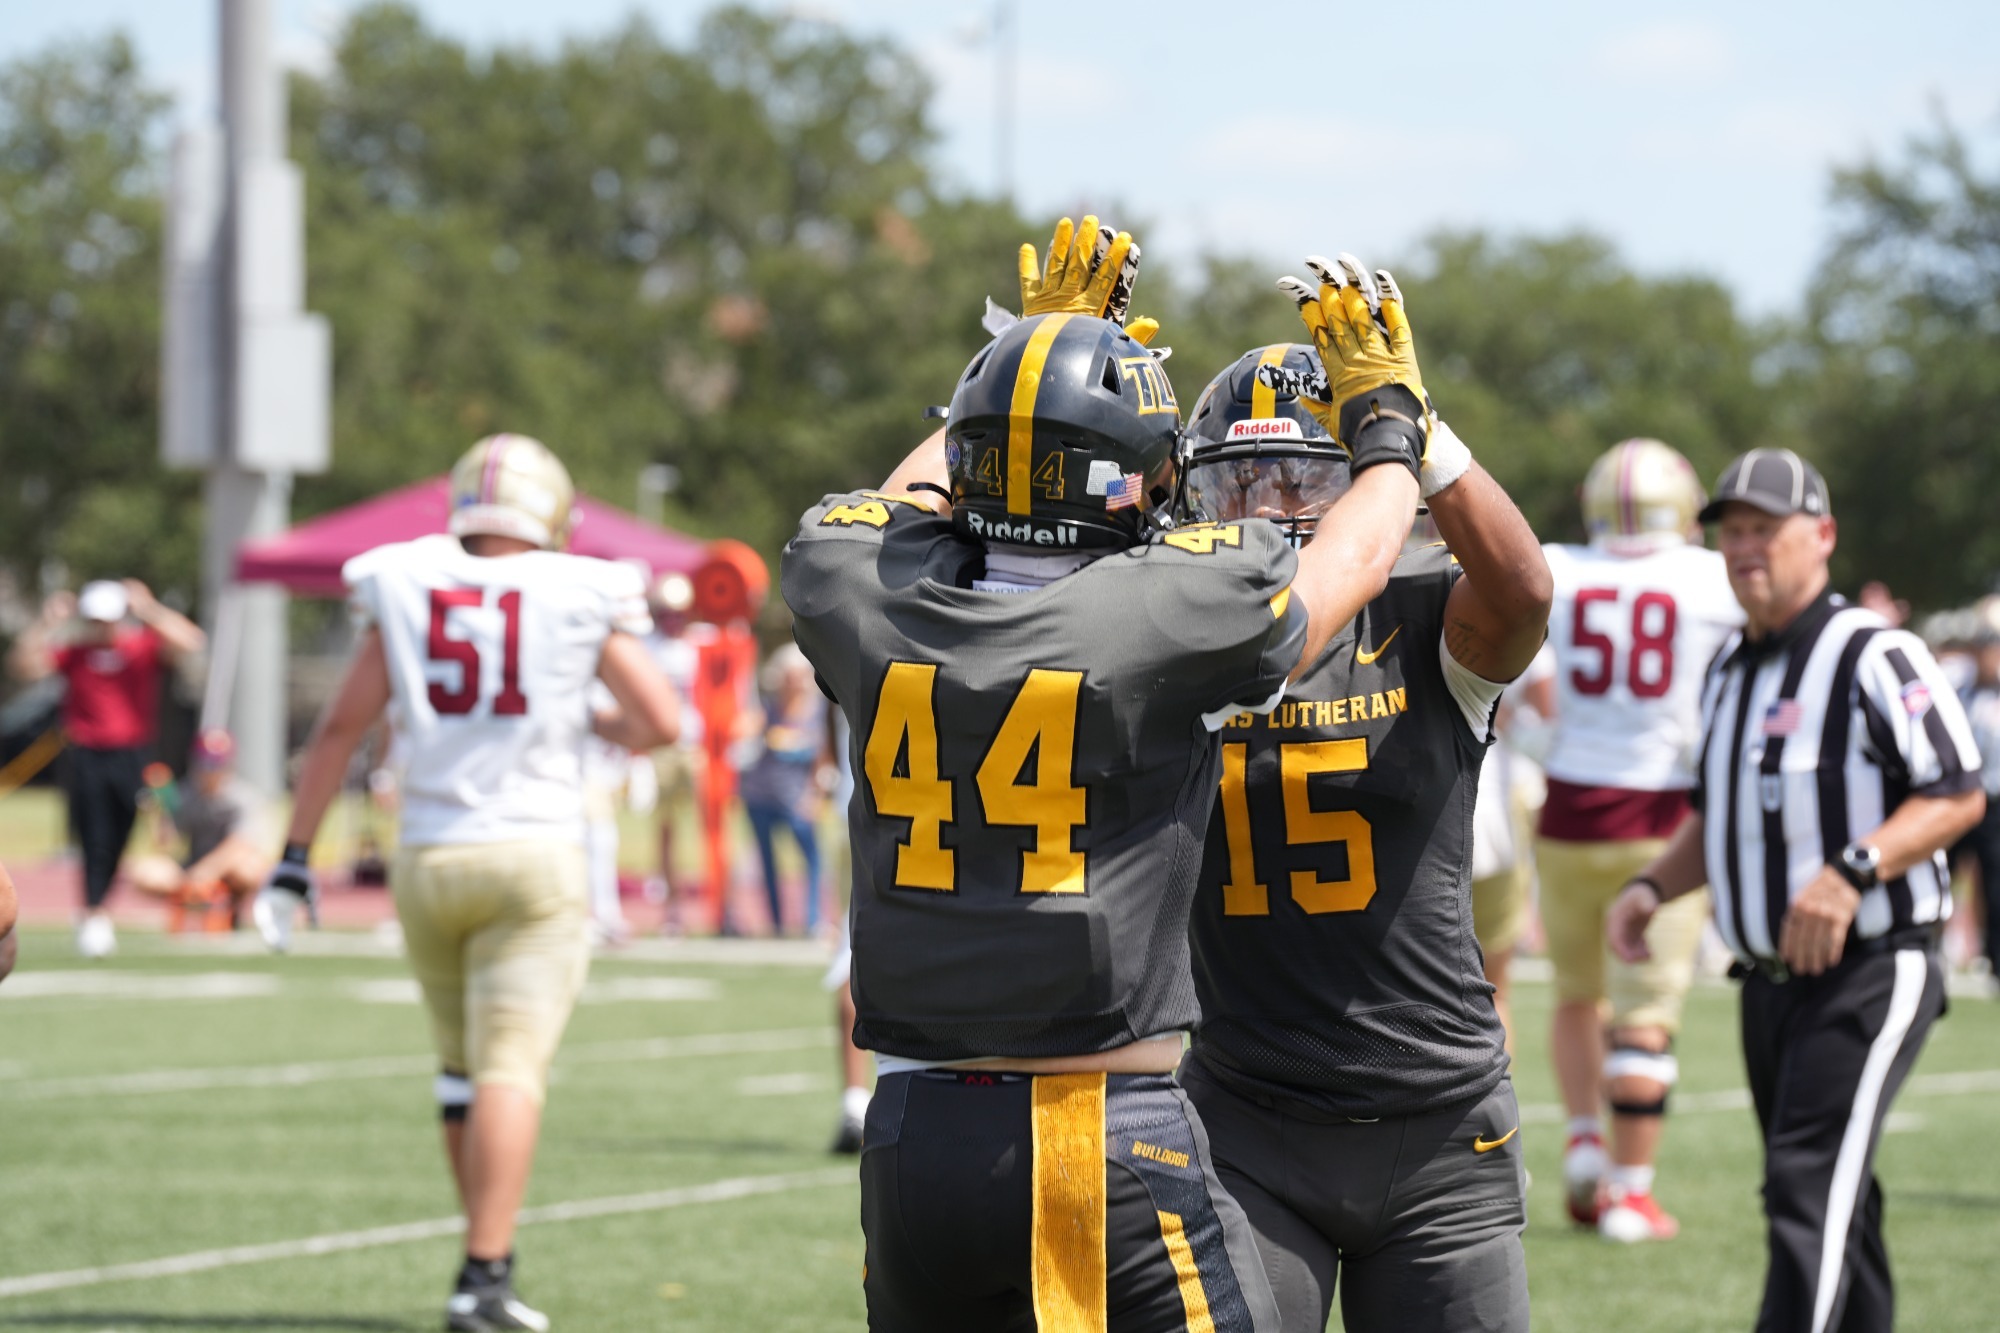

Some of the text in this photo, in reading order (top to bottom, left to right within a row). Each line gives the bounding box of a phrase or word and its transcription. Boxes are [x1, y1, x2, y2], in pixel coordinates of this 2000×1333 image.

[1234, 422, 1291, 436] Riddell
[967, 511, 1078, 546] Riddell
[427, 588, 527, 715] 51
[1570, 588, 1676, 699] 58
[1268, 687, 1408, 729] LUTHERAN
[863, 661, 1088, 895] 44
[1220, 737, 1377, 915] 15
